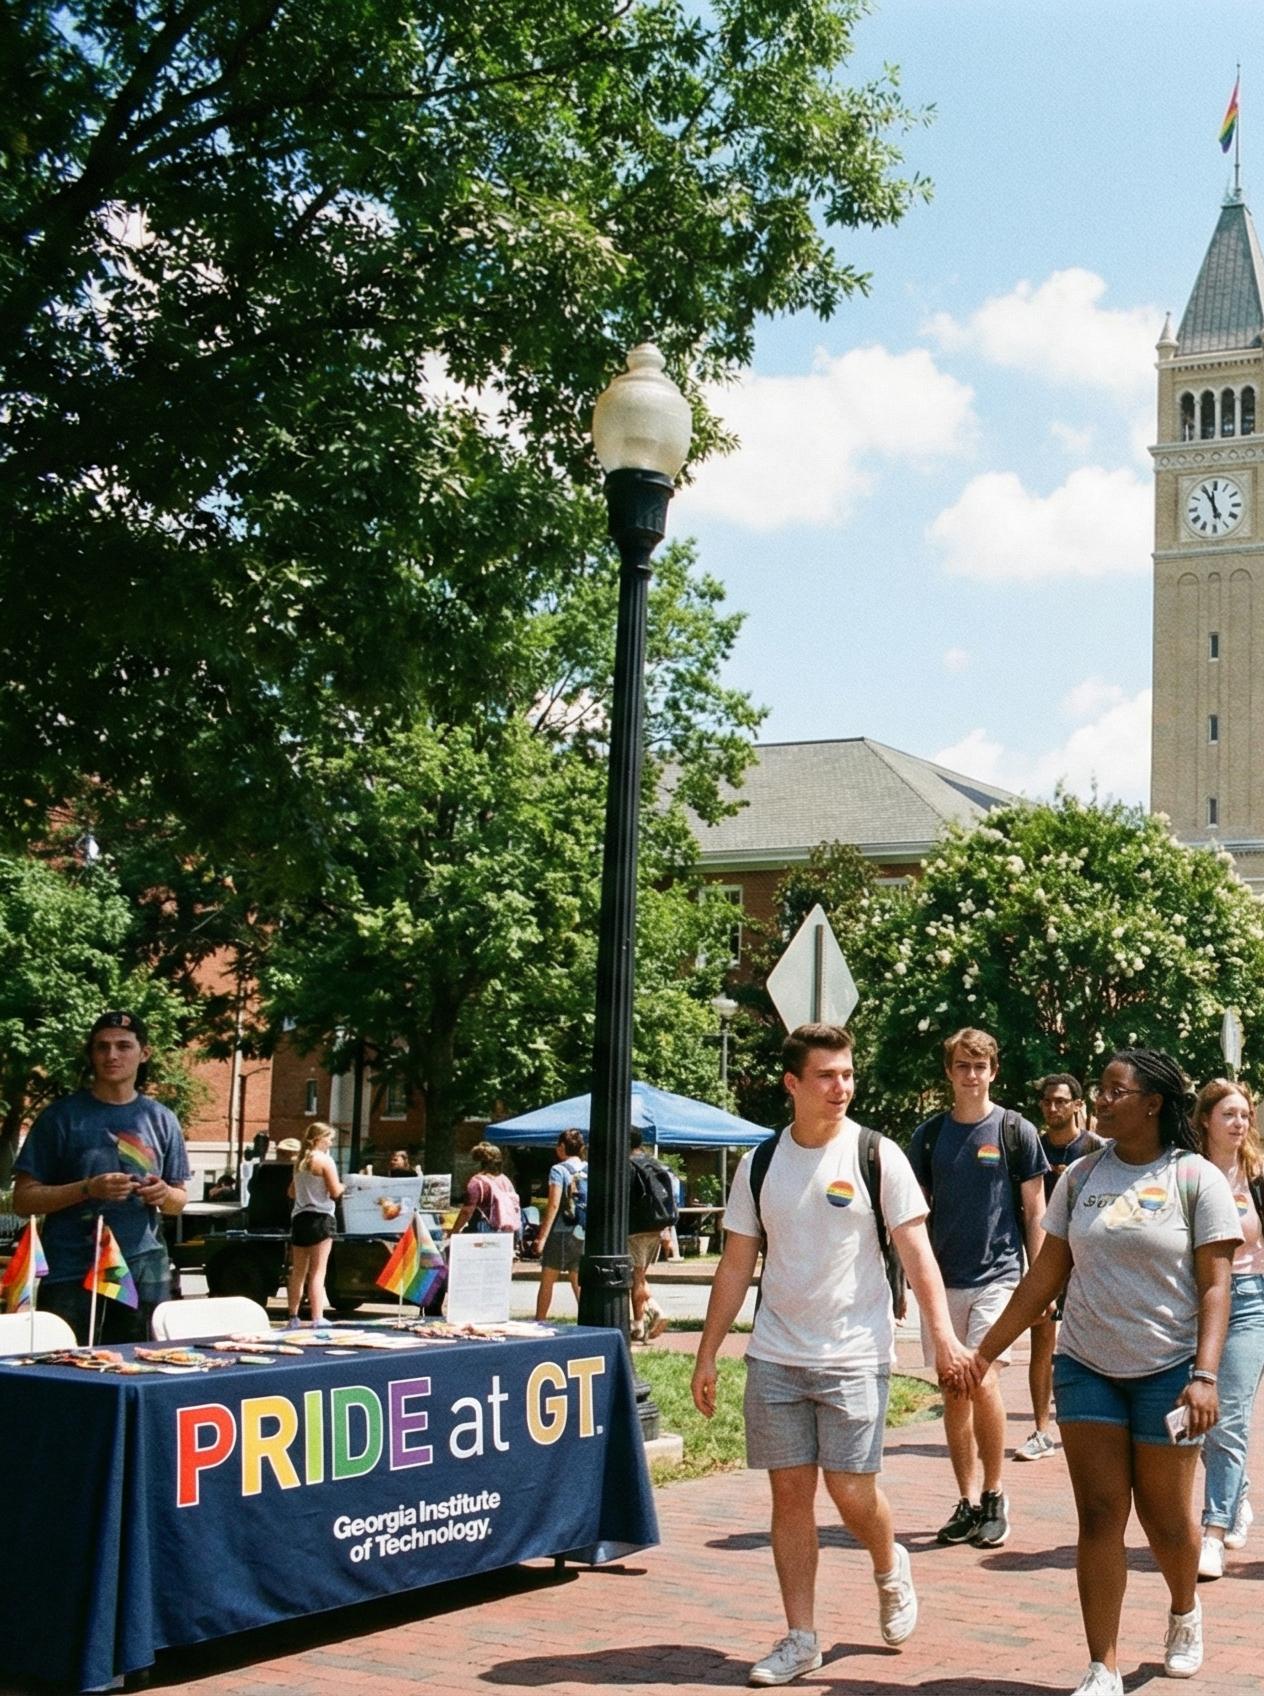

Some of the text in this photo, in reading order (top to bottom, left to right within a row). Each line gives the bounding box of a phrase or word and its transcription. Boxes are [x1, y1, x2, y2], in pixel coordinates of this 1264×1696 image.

[176, 1376, 433, 1508] PRIDE
[449, 1375, 510, 1460] at
[333, 1490, 501, 1540] Georgia Institute
[350, 1537, 372, 1563] of
